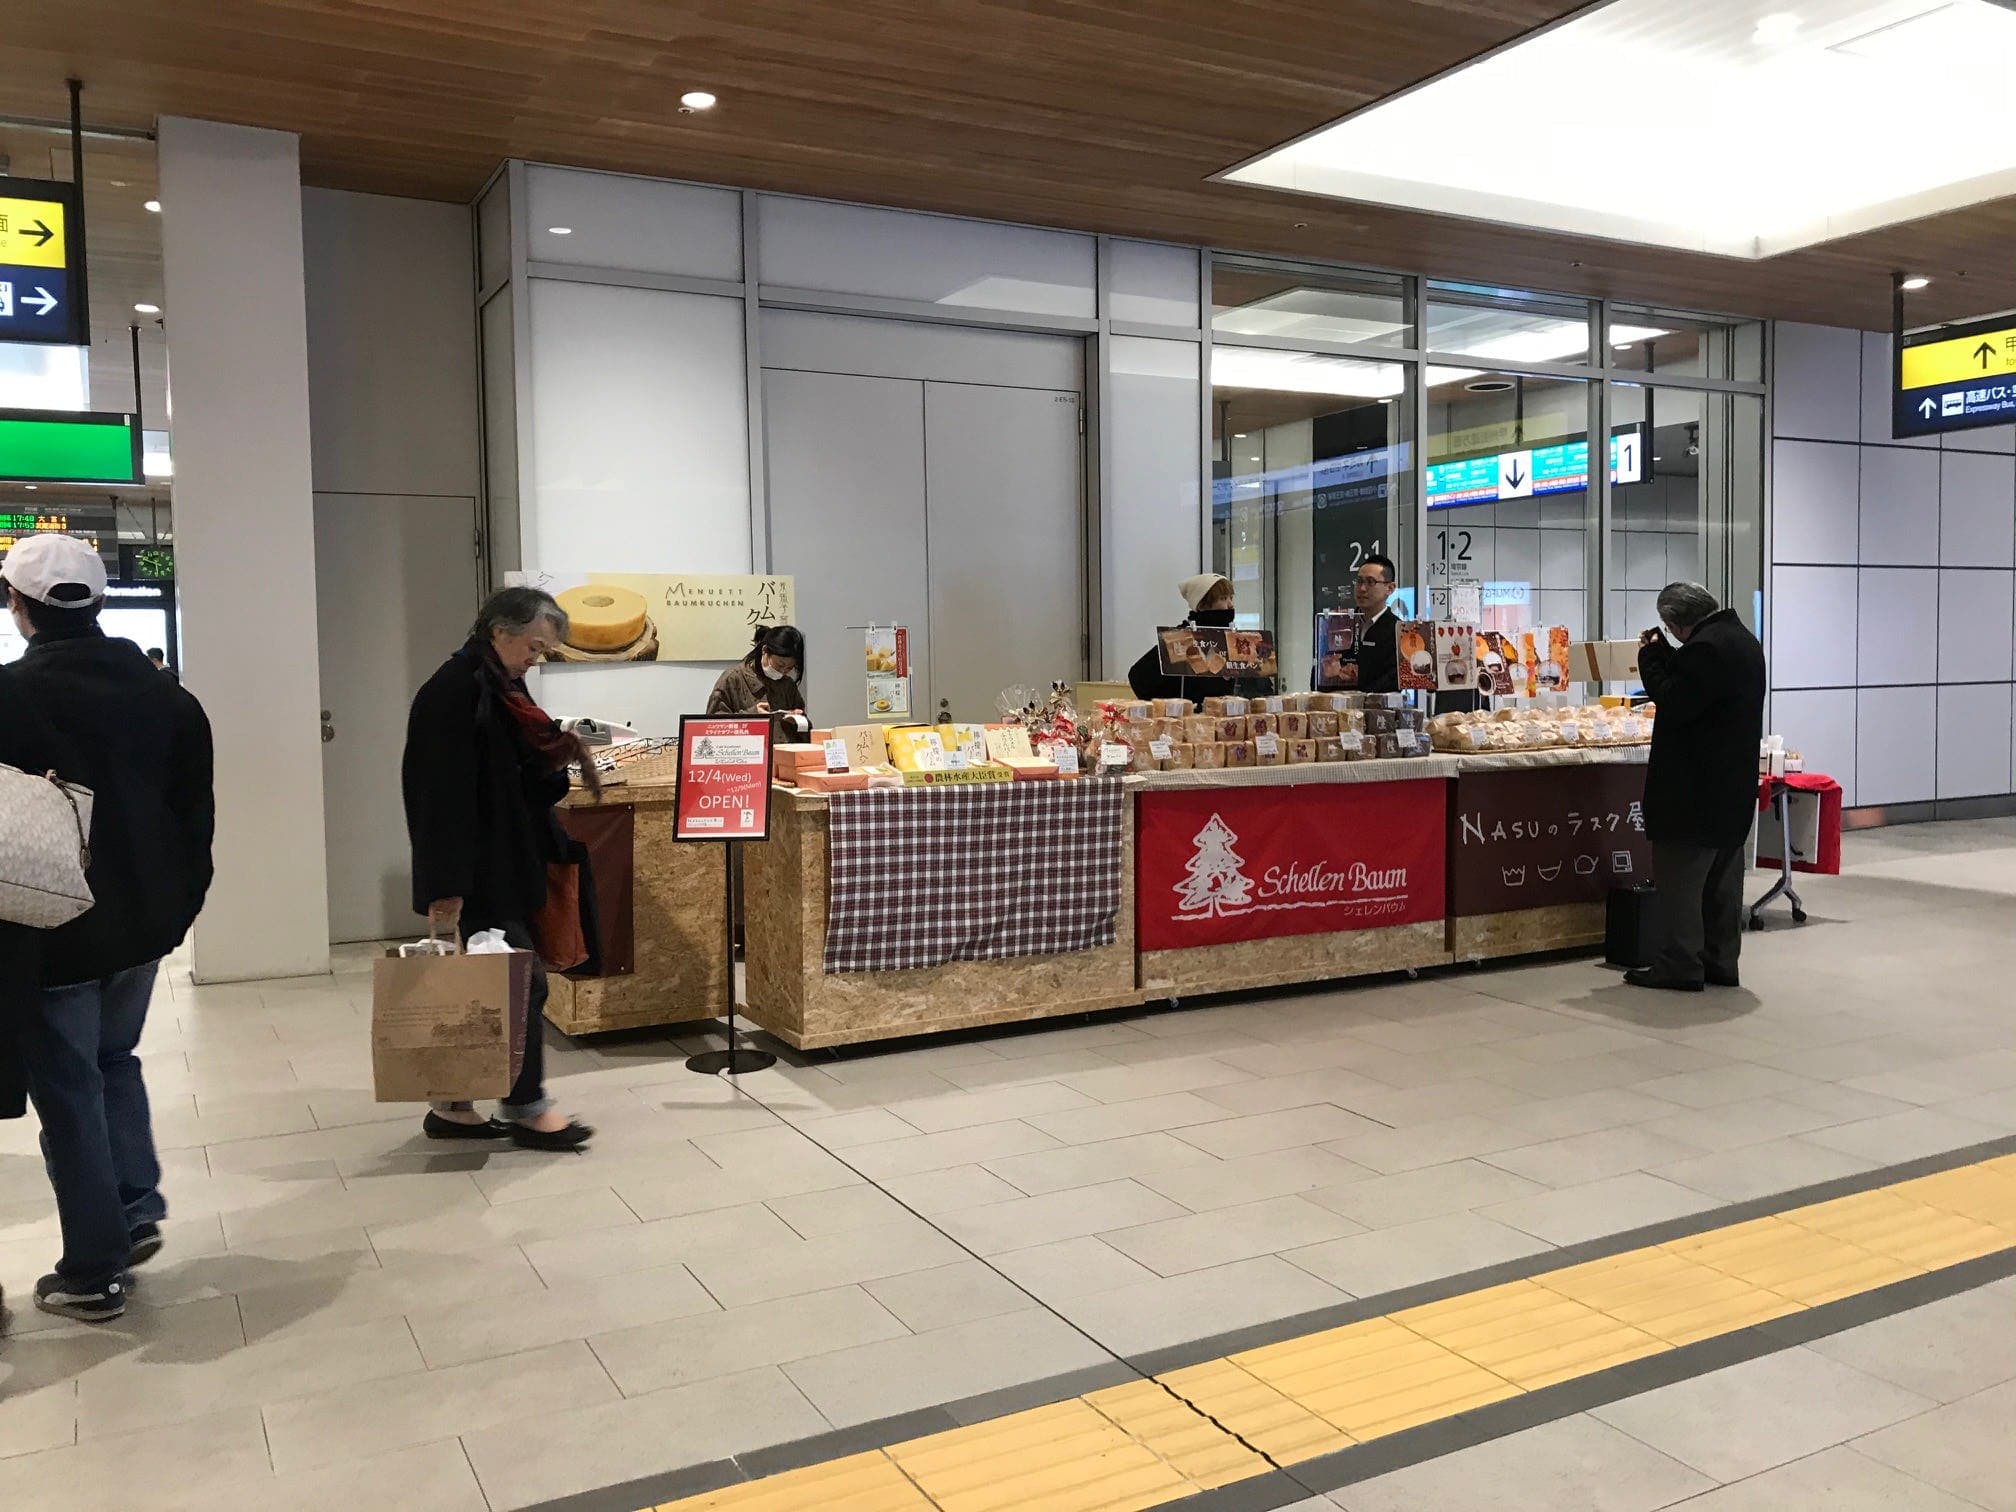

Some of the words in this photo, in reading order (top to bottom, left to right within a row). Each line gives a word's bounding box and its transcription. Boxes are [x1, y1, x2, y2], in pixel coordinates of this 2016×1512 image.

[1624, 443, 1632, 472] 1
[688, 769, 752, 785] 12/4(Wed)
[699, 794, 750, 809] OPEN!
[1257, 860, 1344, 898] Schellen
[1347, 861, 1408, 893] Baum
